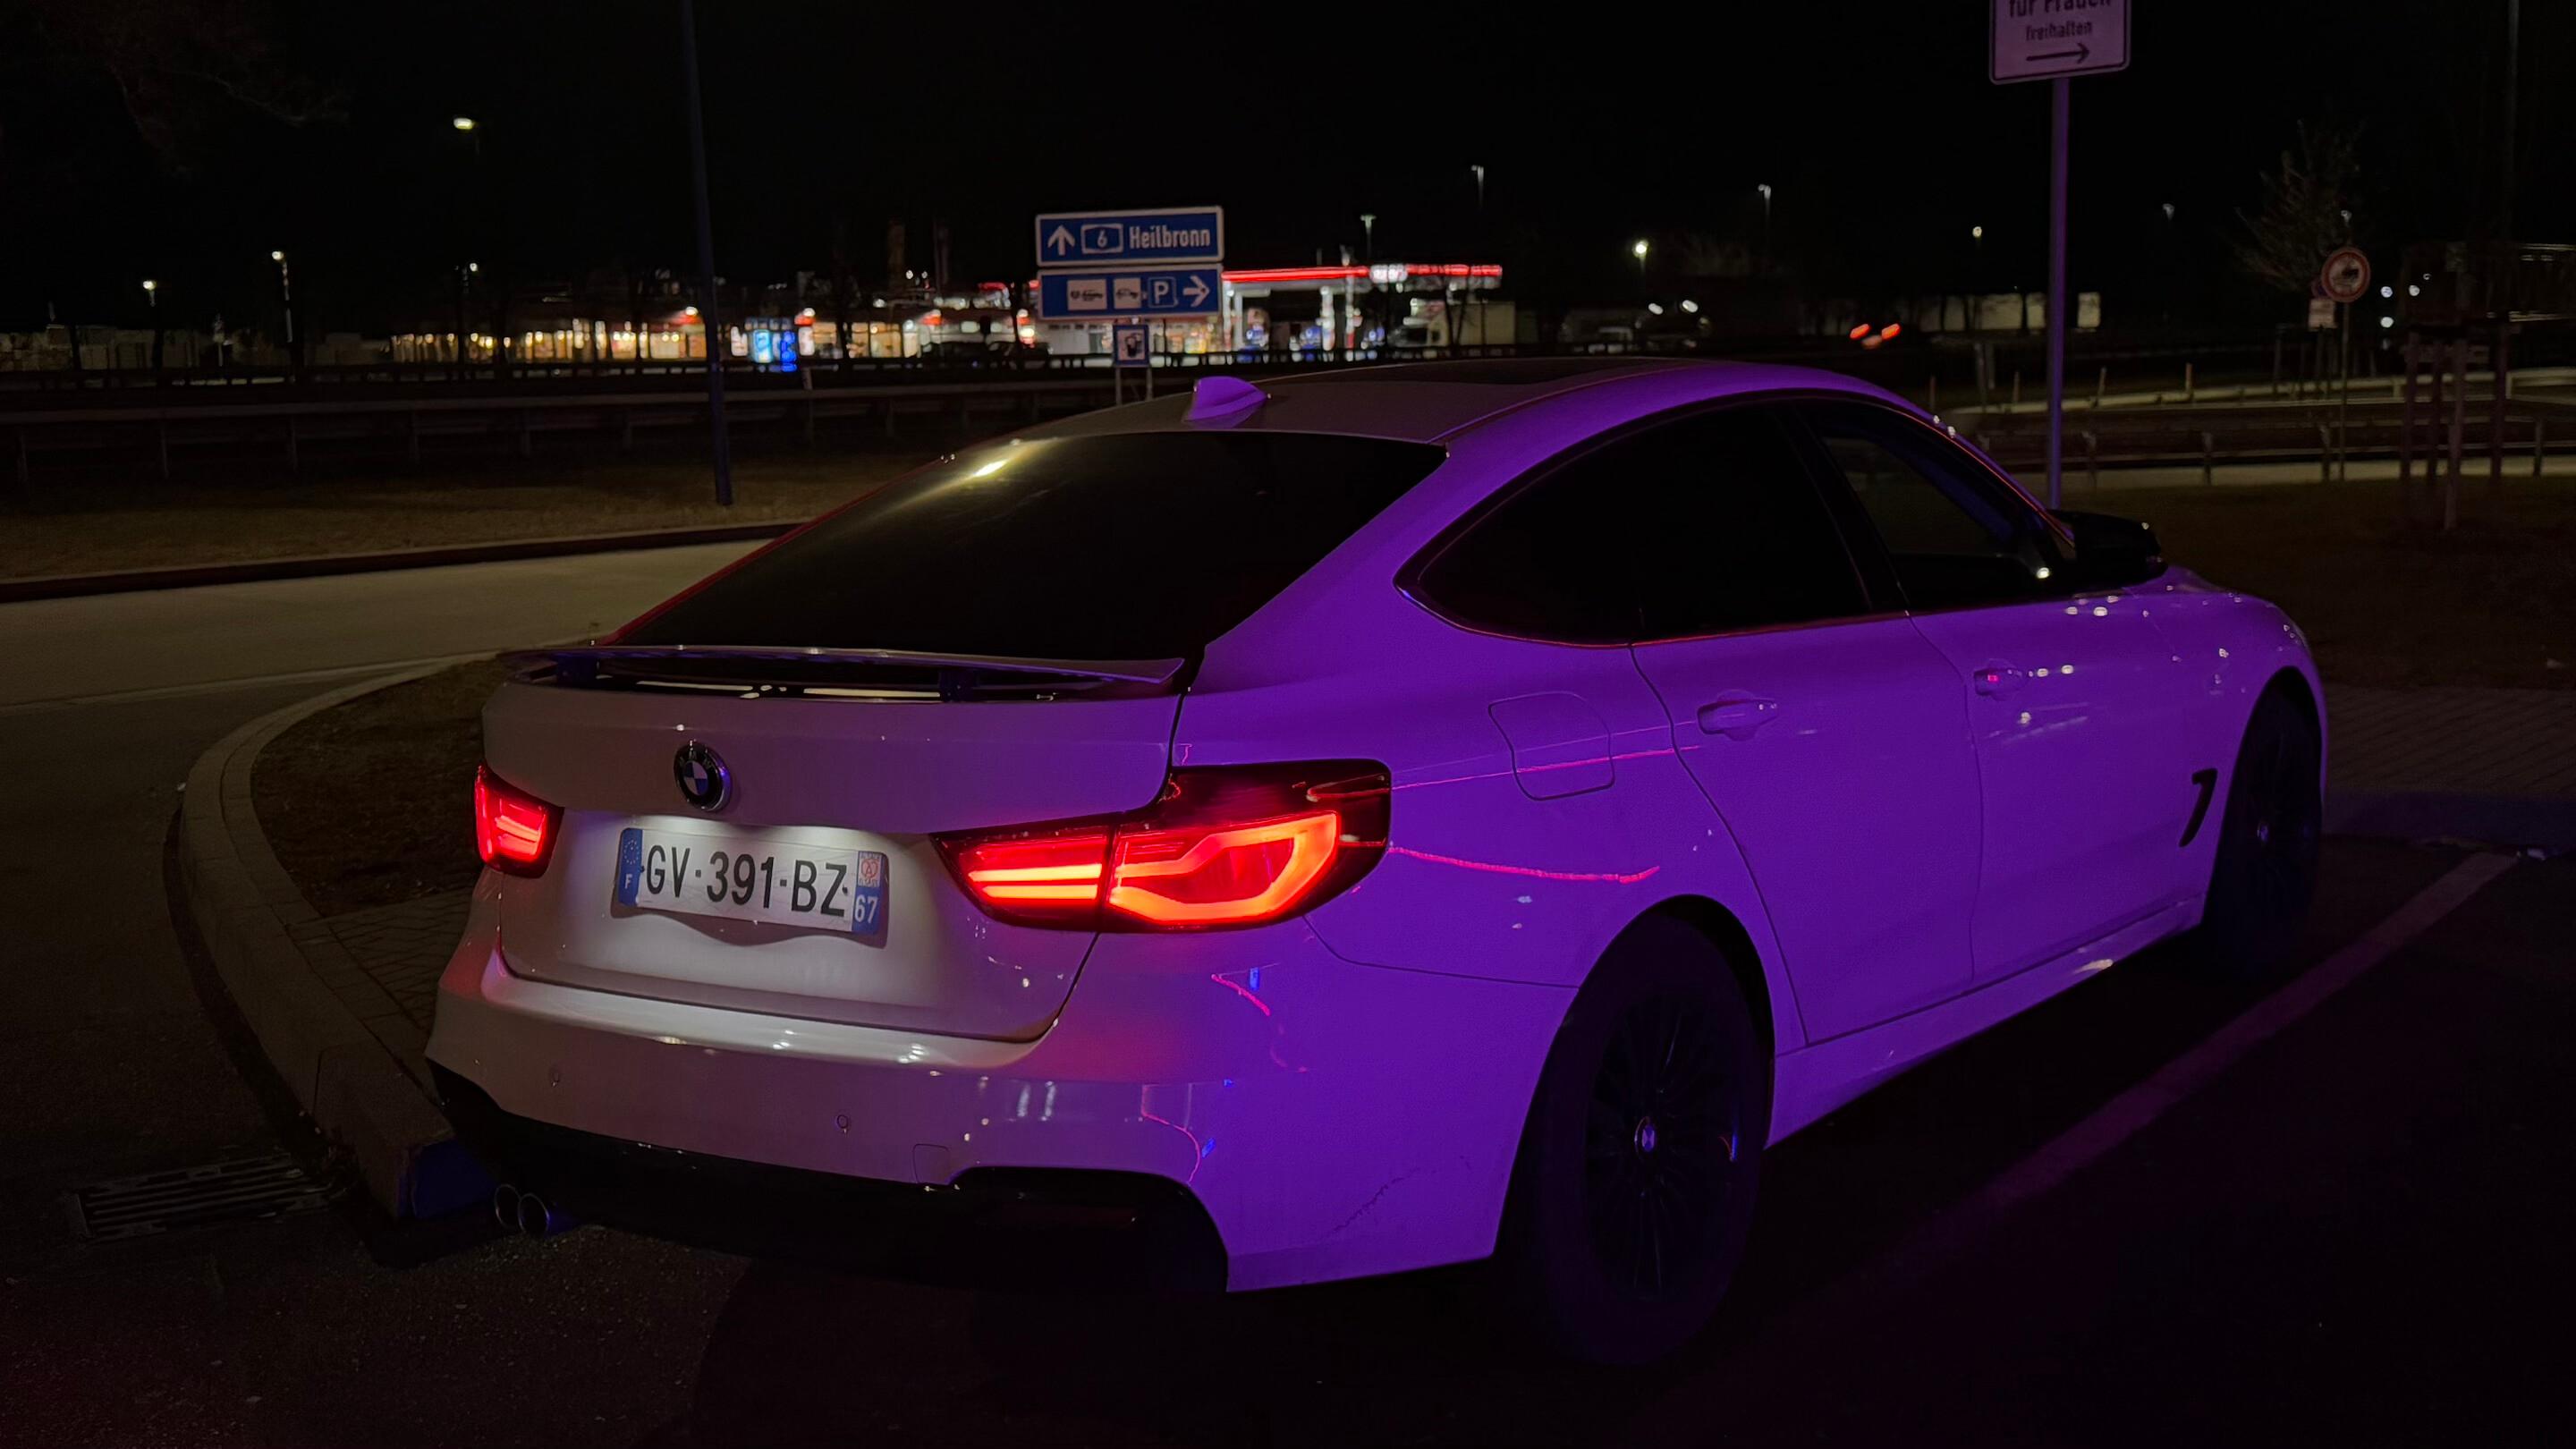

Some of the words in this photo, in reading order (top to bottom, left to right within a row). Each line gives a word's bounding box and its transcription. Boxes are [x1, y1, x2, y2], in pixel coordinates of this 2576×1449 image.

[1097, 228, 1107, 248] 6
[1129, 224, 1211, 250] Heilbronn
[1154, 281, 1169, 304] P
[624, 873, 633, 889] F
[854, 894, 878, 924] 67
